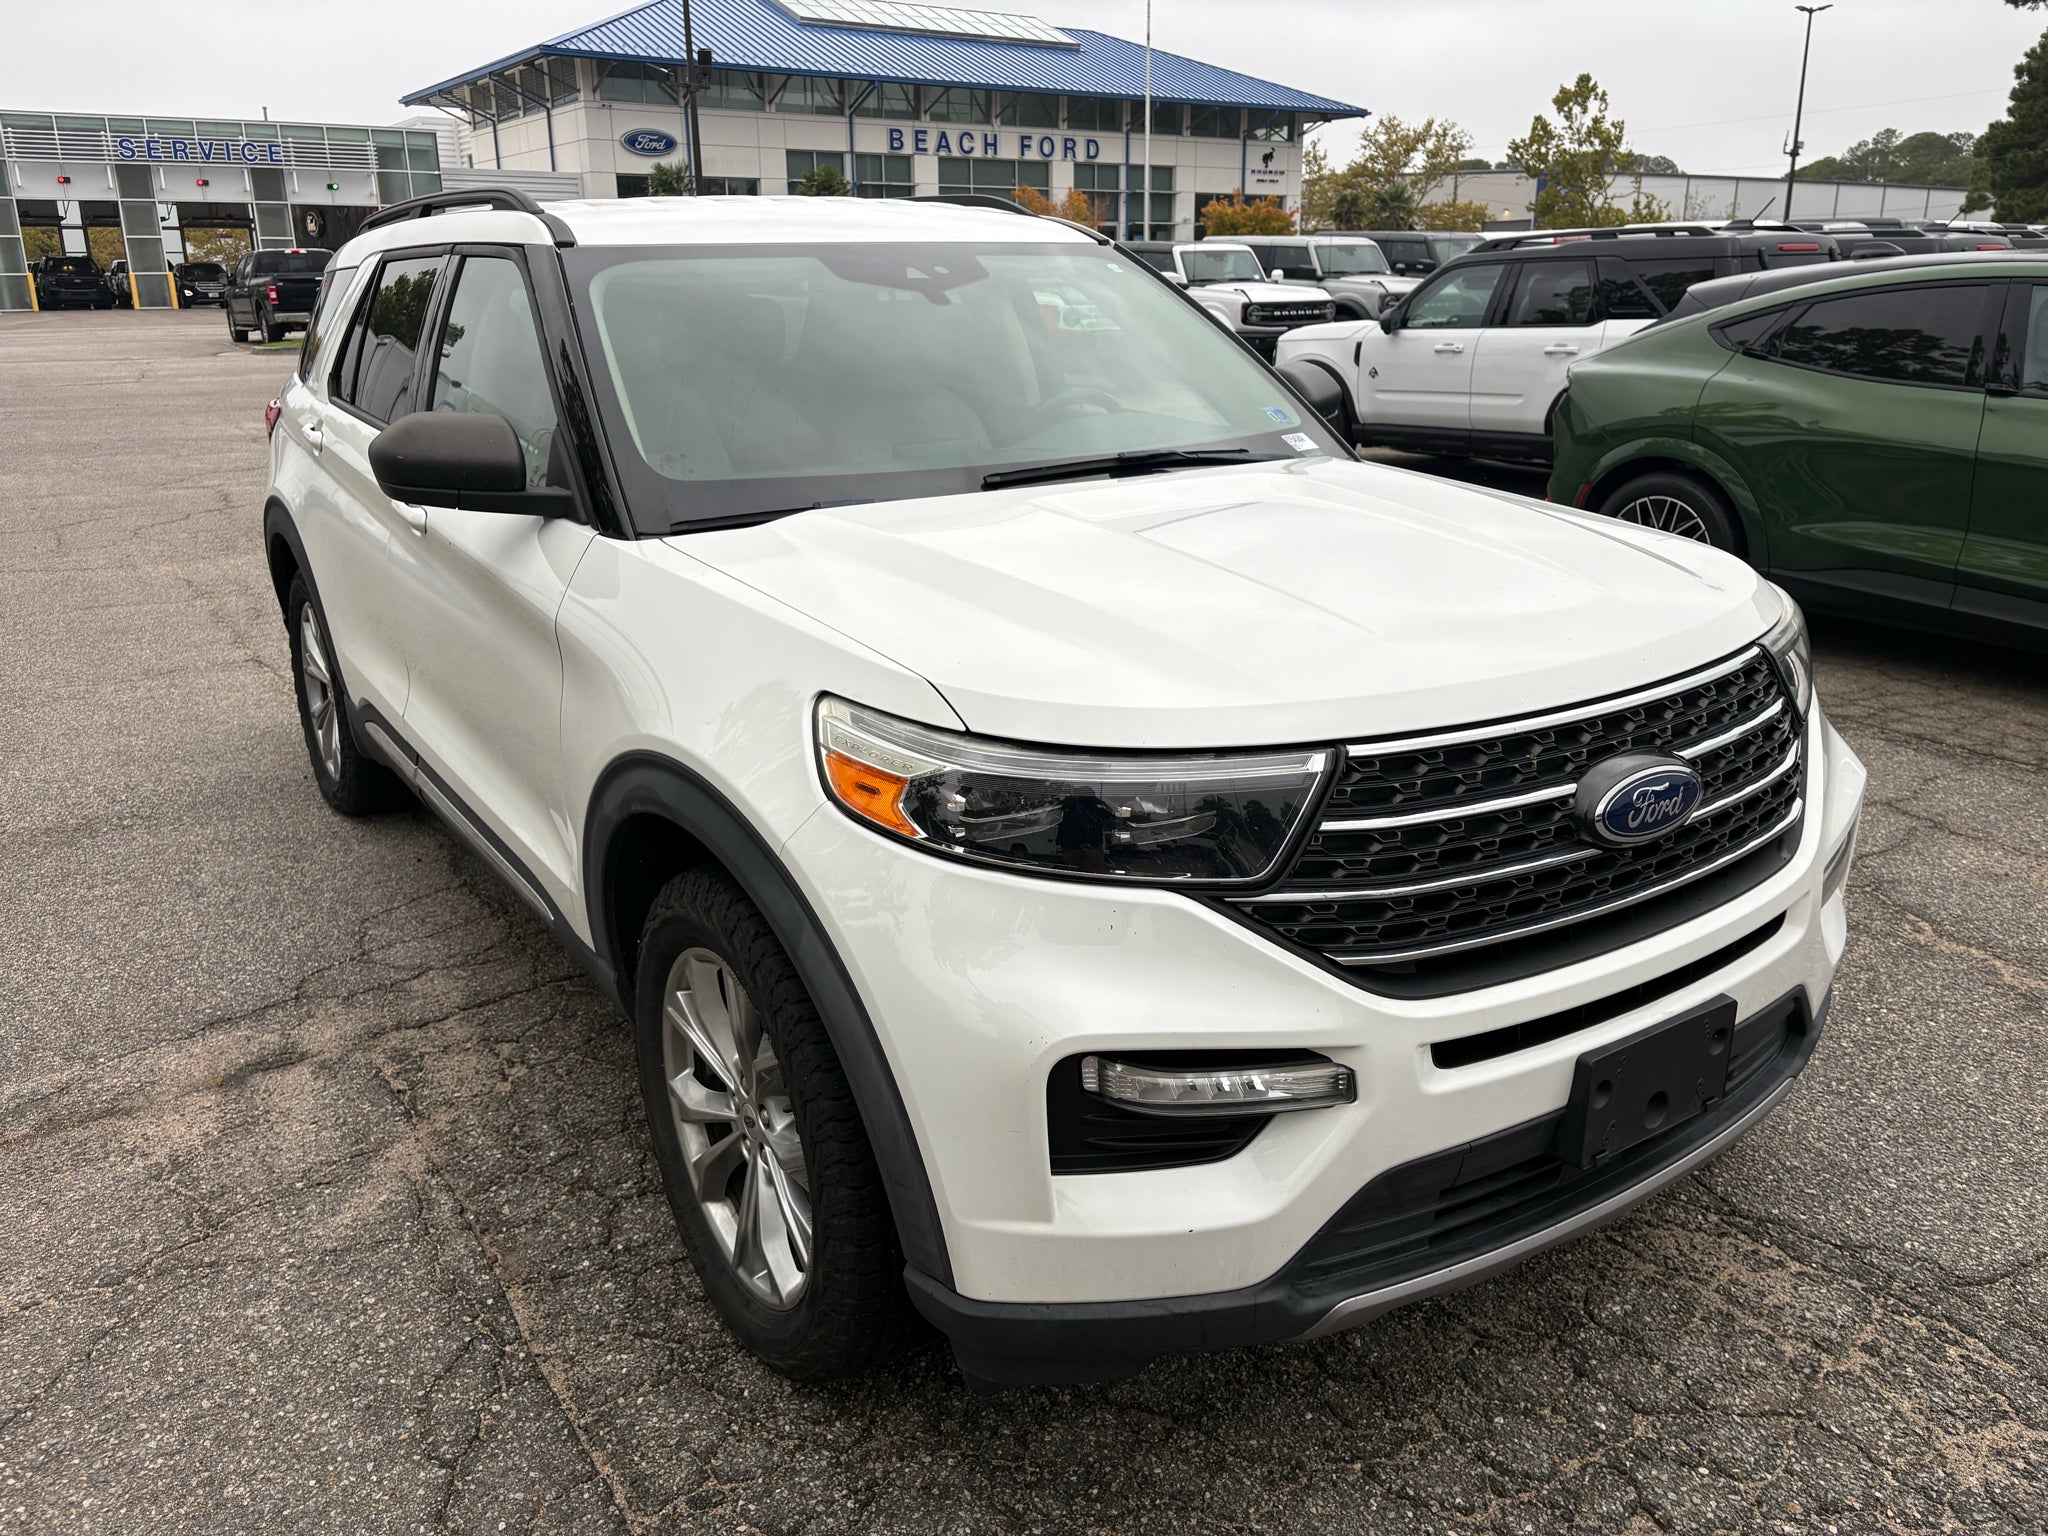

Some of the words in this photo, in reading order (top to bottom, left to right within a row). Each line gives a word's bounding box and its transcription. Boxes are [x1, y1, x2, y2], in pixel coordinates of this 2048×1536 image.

[117, 138, 284, 164] SERVICE
[635, 134, 667, 150] Ford
[888, 127, 999, 156] BEACH
[1019, 134, 1100, 160] FORD
[834, 735, 914, 771] EXPLORER
[1627, 781, 1685, 829] Ford
